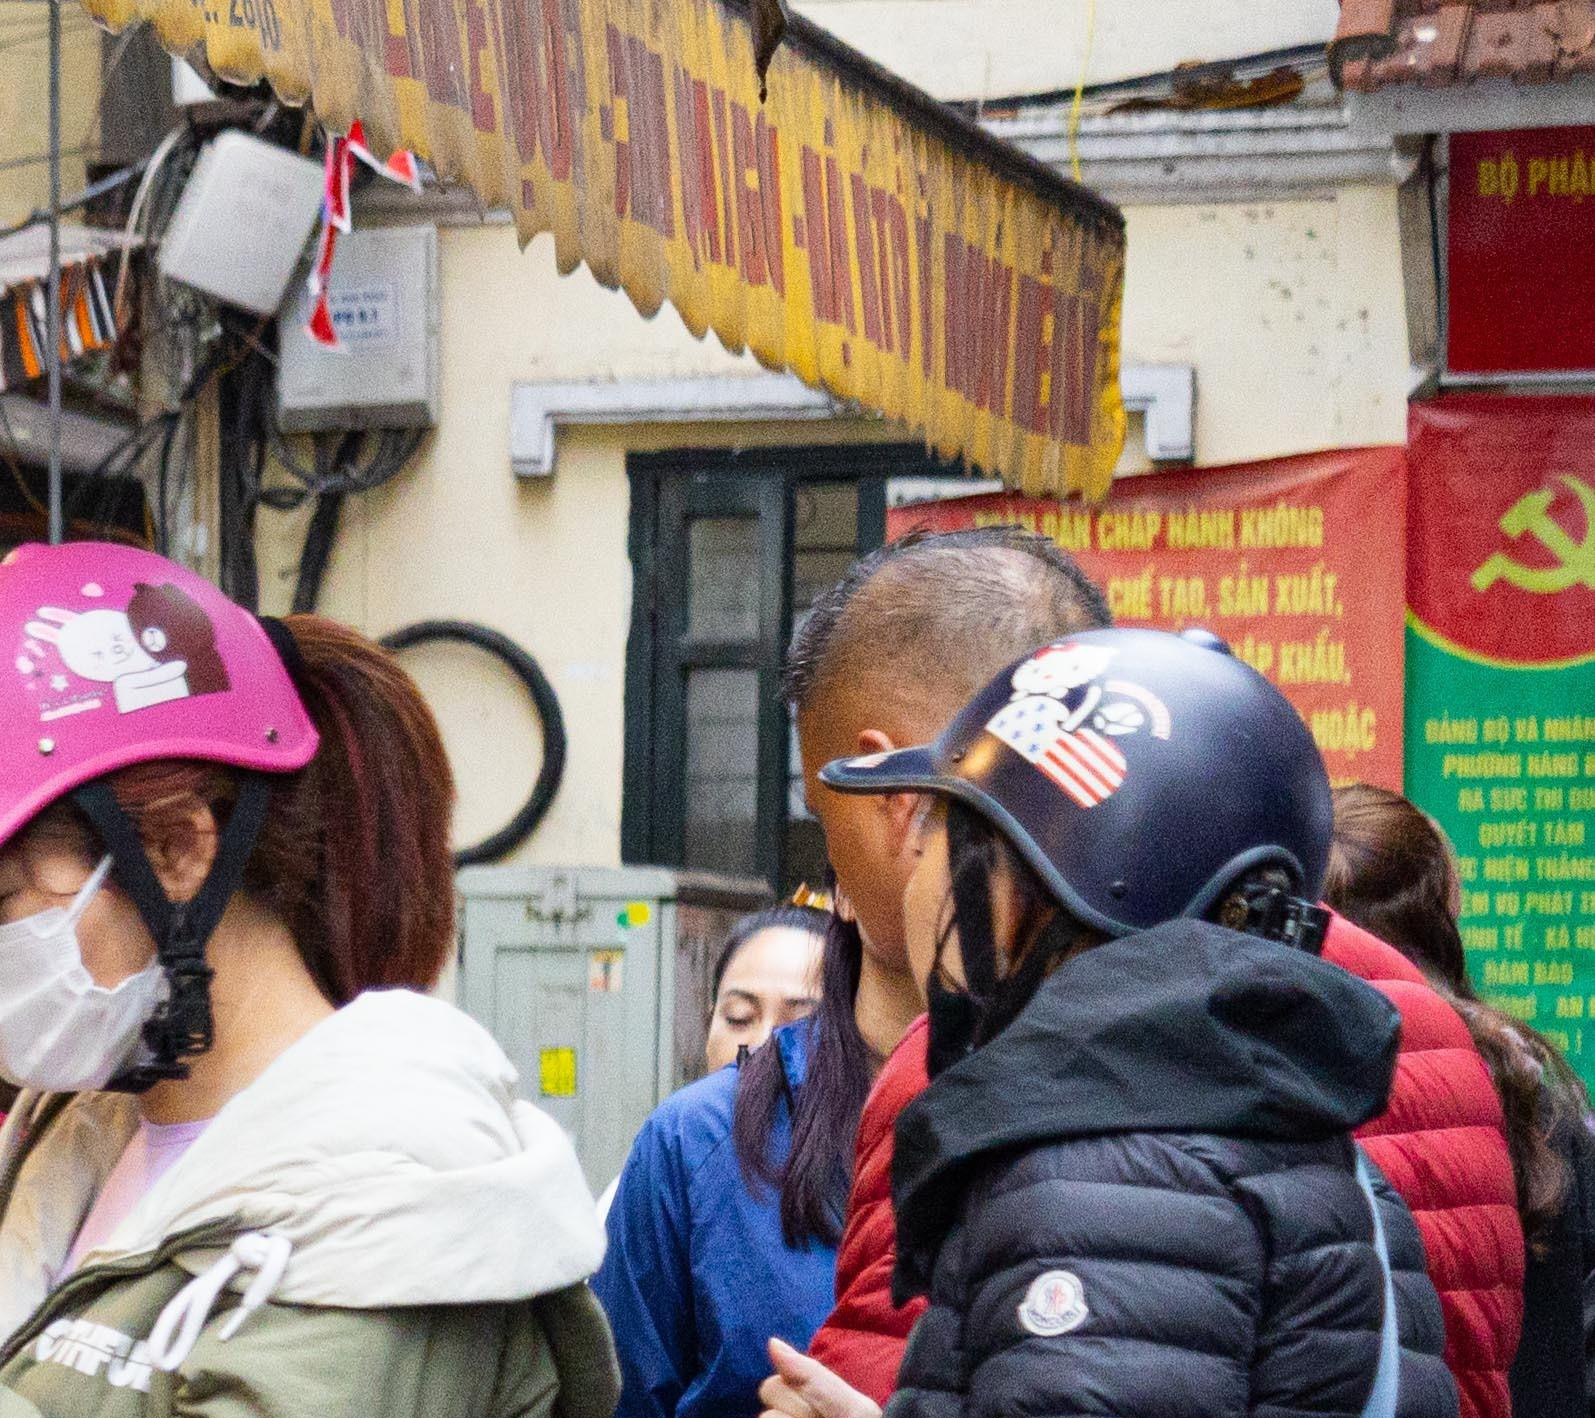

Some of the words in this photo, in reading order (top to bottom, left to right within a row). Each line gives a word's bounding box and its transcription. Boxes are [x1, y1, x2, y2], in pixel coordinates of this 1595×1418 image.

[1478, 149, 1518, 206] BỘ
[1528, 146, 1595, 205] PHẬ
[1219, 558, 1269, 617] SẢN
[1233, 635, 1273, 674] ẬP
